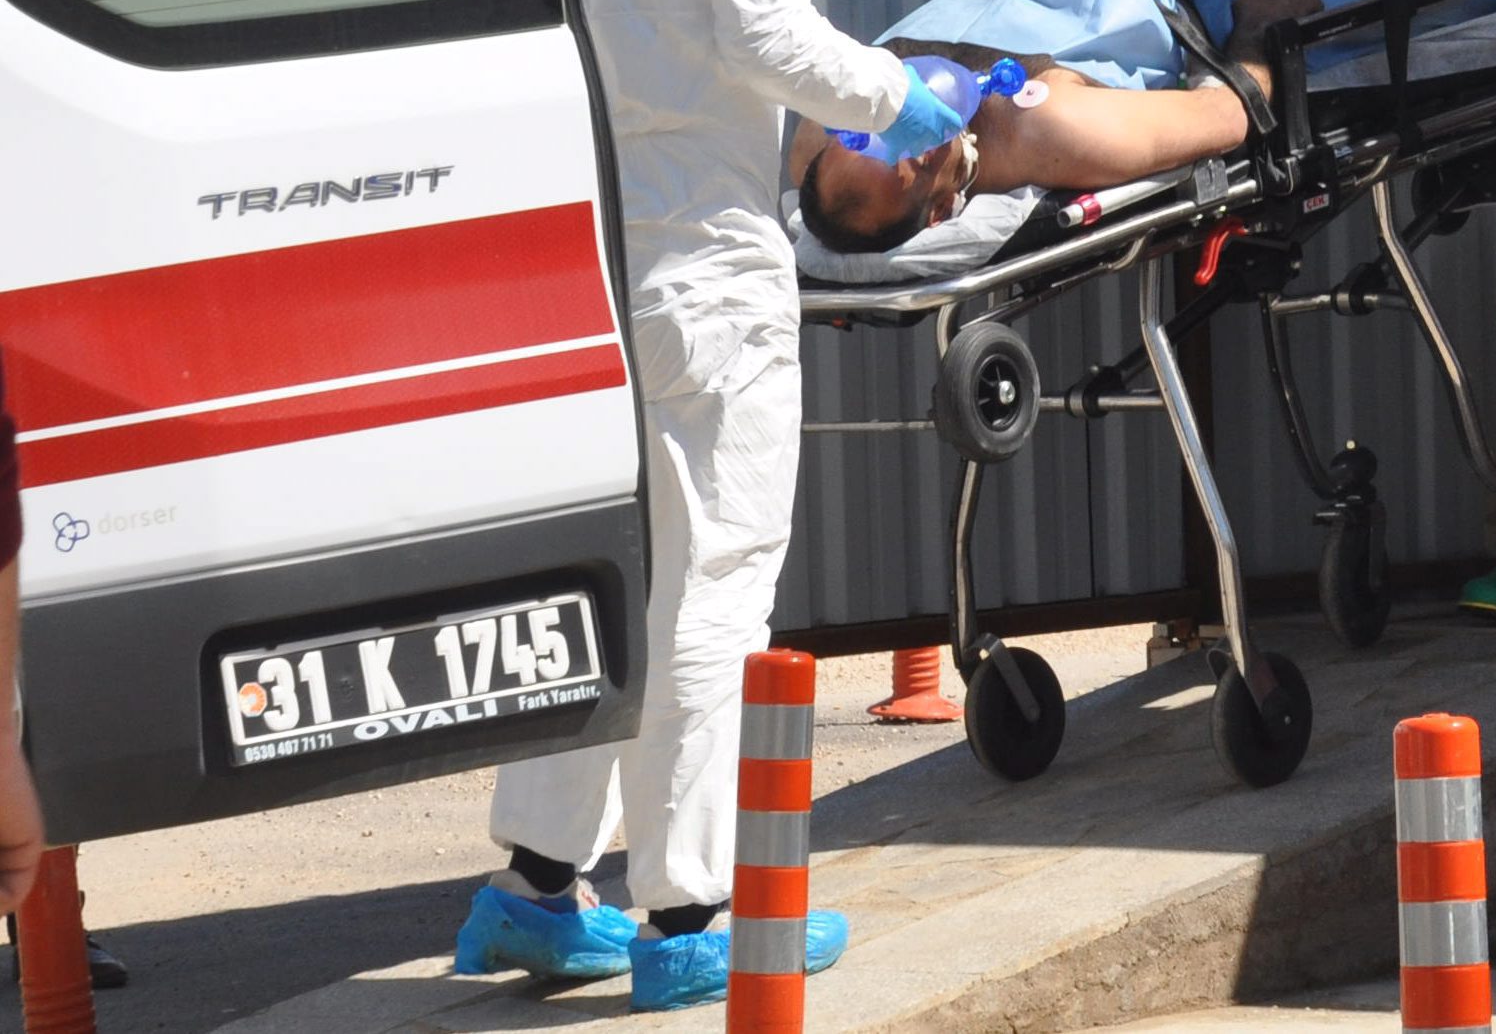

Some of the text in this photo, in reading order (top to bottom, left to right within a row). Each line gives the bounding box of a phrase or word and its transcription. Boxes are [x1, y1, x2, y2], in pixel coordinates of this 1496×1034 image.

[197, 165, 455, 220] TRANSIT
[97, 506, 177, 534] dorser
[258, 607, 570, 732] 31 K 1745
[353, 698, 498, 741] OVALI
[518, 692, 549, 711] Fark
